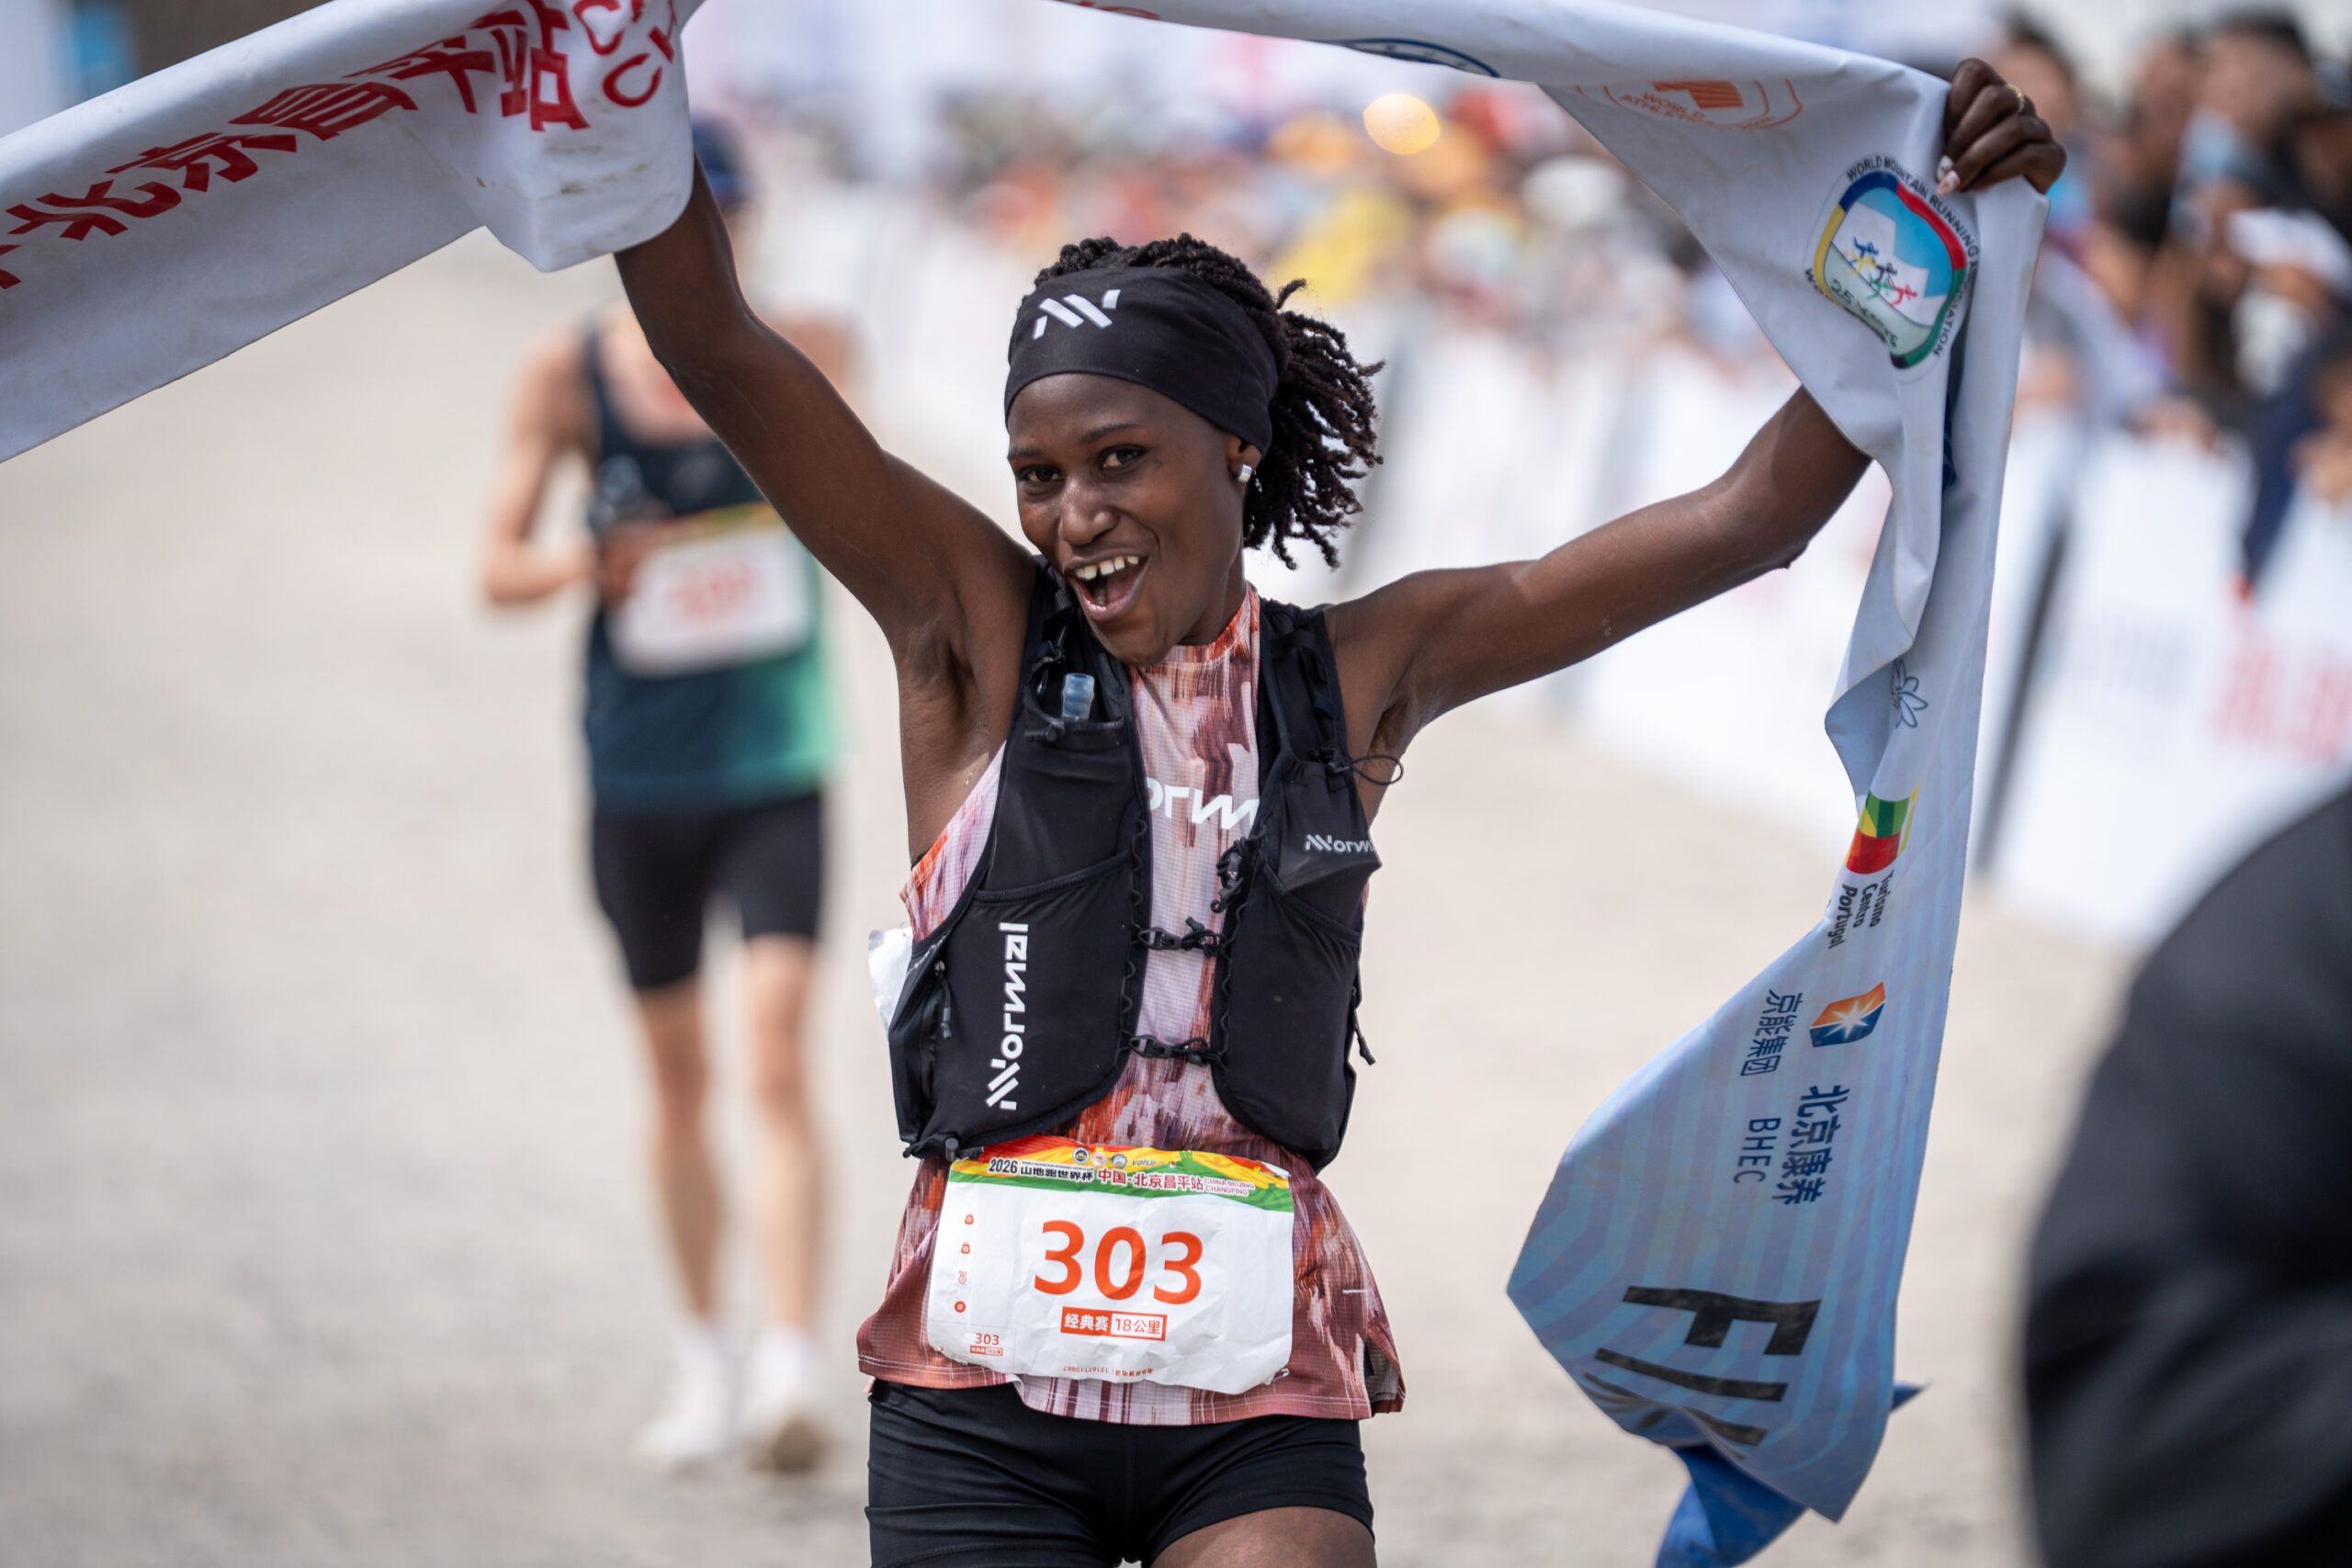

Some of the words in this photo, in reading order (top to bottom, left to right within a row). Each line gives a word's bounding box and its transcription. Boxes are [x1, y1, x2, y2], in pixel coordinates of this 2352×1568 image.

[0, 0, 592, 290] 北京昌平站
[1846, 155, 1883, 182] WORLD
[1883, 155, 1929, 198] MOUNTAIN
[1929, 193, 1980, 258] RUNNING
[1827, 883, 1859, 950] Portugal
[1852, 883, 1879, 929] Centro
[1868, 869, 1894, 928] Turismo
[1739, 988, 1804, 1077] 京能集团
[989, 1157, 1018, 1174] 2026
[1020, 1165, 1094, 1181] 山地跑世界杯
[1098, 1168, 1204, 1191] 中国·北京昌平站
[1733, 1116, 1782, 1185] BHEC
[1771, 1084, 1850, 1206] 北京康养
[1204, 1178, 1227, 1187] CHINA
[1204, 1185, 1250, 1196] CHANGPING
[1034, 1219, 1204, 1305] 303
[975, 1332, 1001, 1347] 303
[1064, 1313, 1110, 1332] 经典赛
[1114, 1317, 1161, 1336] 18公里
